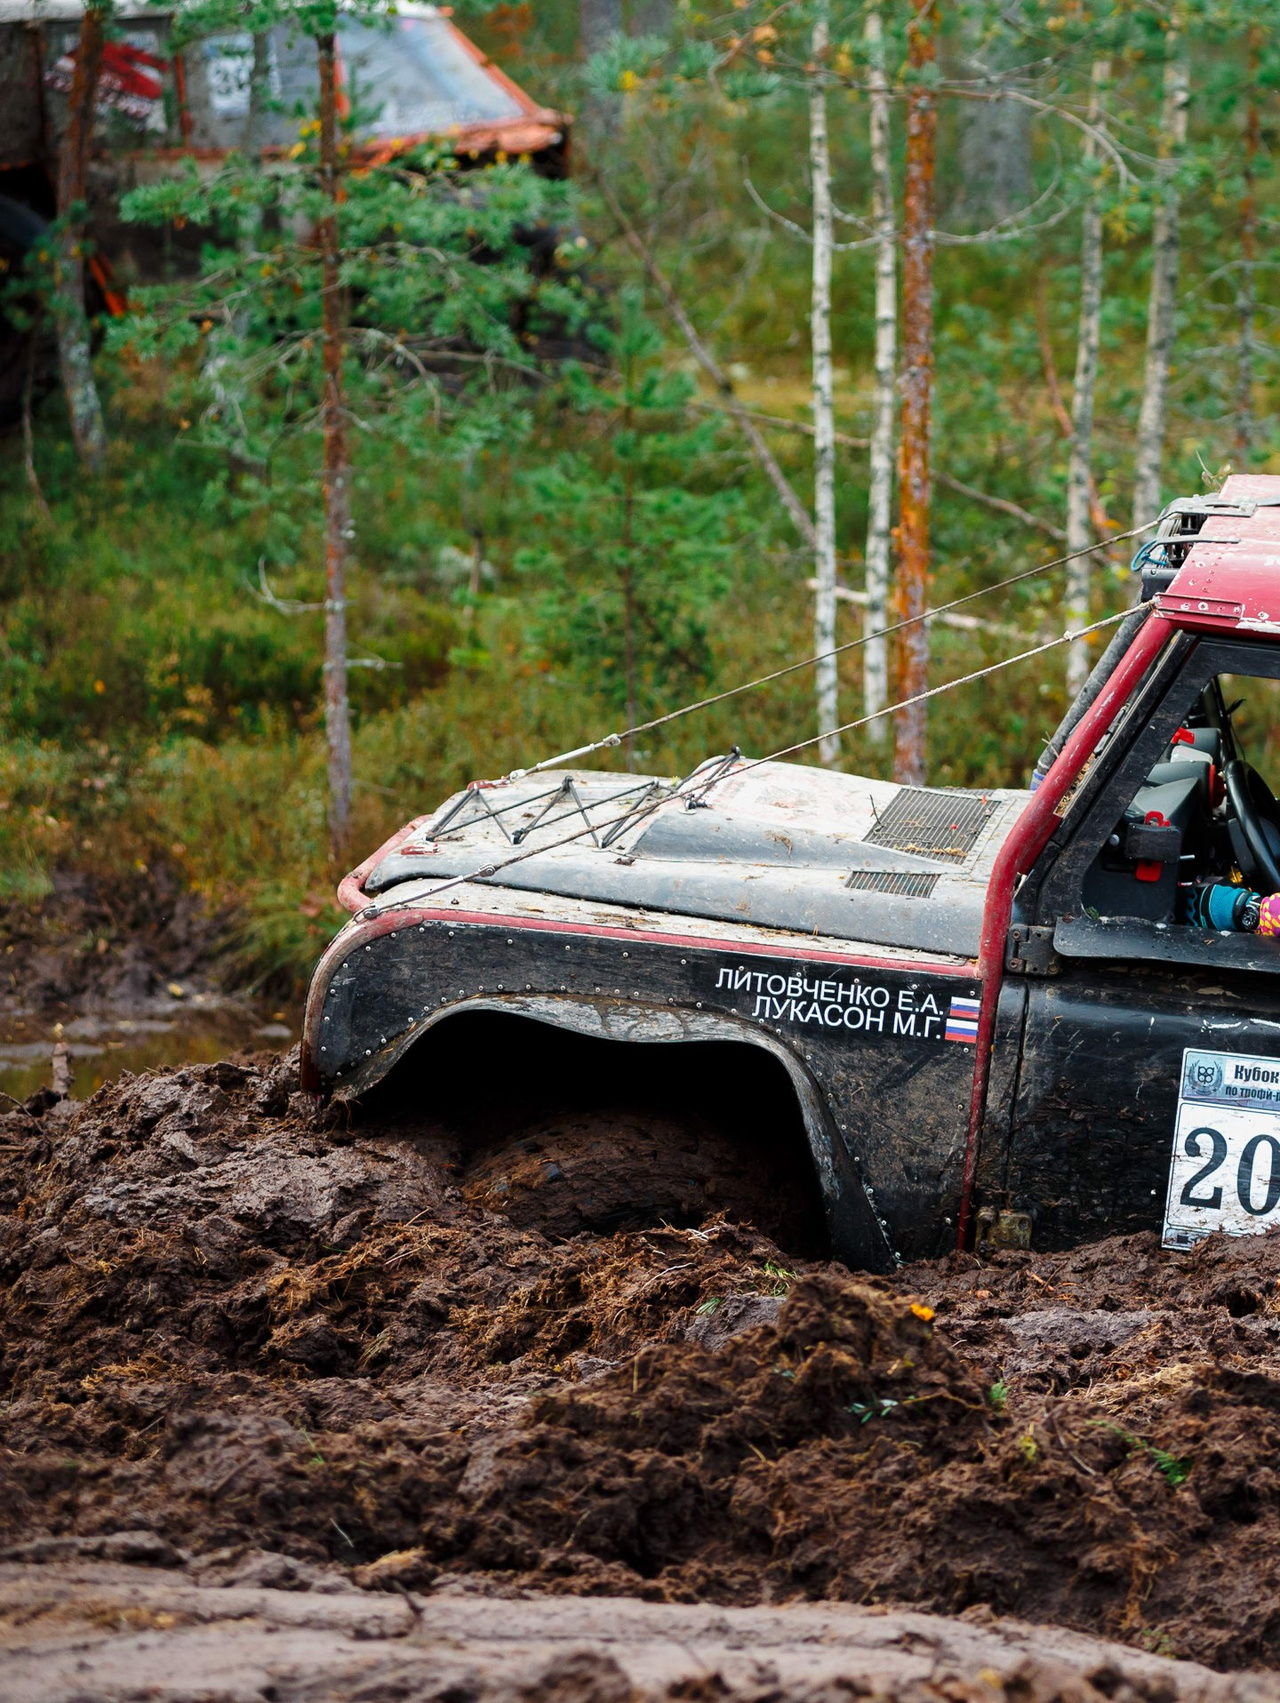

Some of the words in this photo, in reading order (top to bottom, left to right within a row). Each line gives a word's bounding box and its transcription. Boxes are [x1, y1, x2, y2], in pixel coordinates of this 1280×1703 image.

[715, 967, 890, 1008] ЛИТОВЧЕНКО
[897, 990, 944, 1015] Е.А.
[752, 995, 884, 1032] ЛУКАСОН
[892, 1011, 941, 1040] М.Г.
[1234, 1064, 1280, 1084] Кубок
[1225, 1086, 1238, 1097] по
